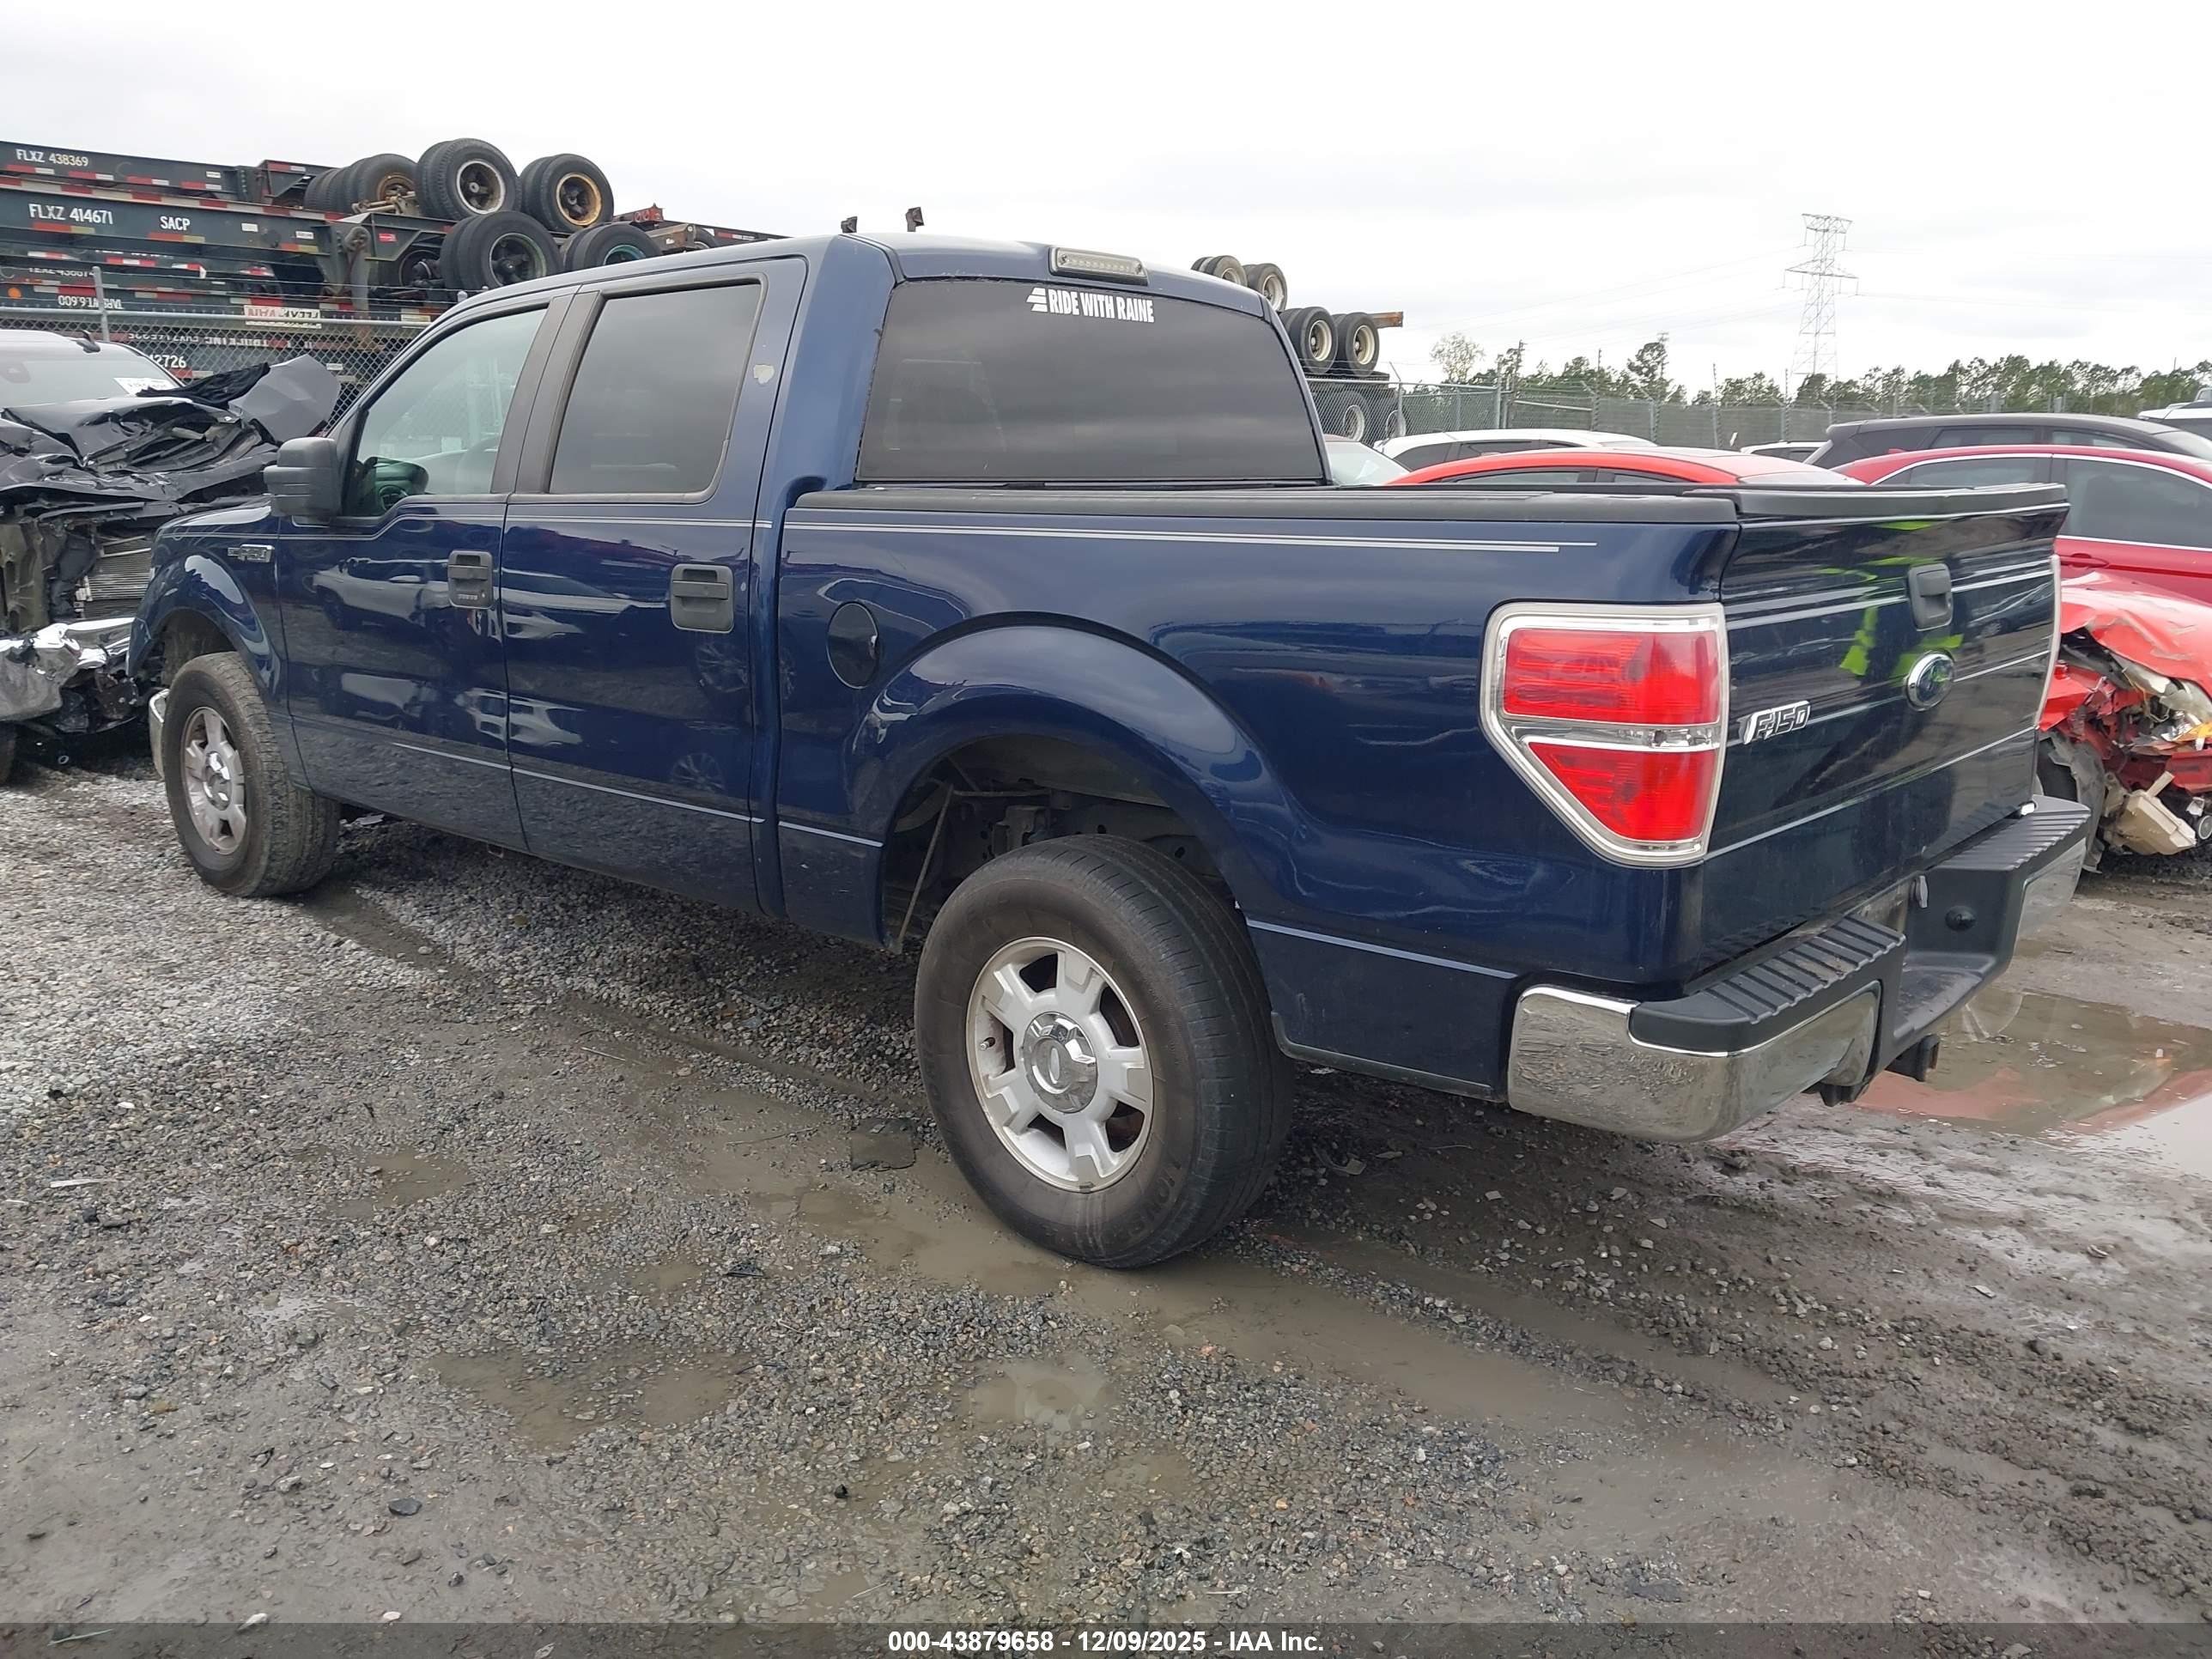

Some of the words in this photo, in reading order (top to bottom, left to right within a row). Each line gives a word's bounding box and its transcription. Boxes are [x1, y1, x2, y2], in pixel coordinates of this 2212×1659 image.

[15, 149, 45, 163] FLXZ
[48, 153, 89, 167] 438369
[28, 204, 66, 221] FLXZ
[70, 208, 113, 225] 414671
[160, 216, 191, 231] SACP
[1048, 289, 1080, 315] RIDE
[1079, 292, 1115, 319] WITH
[1116, 296, 1155, 323] RAINE
